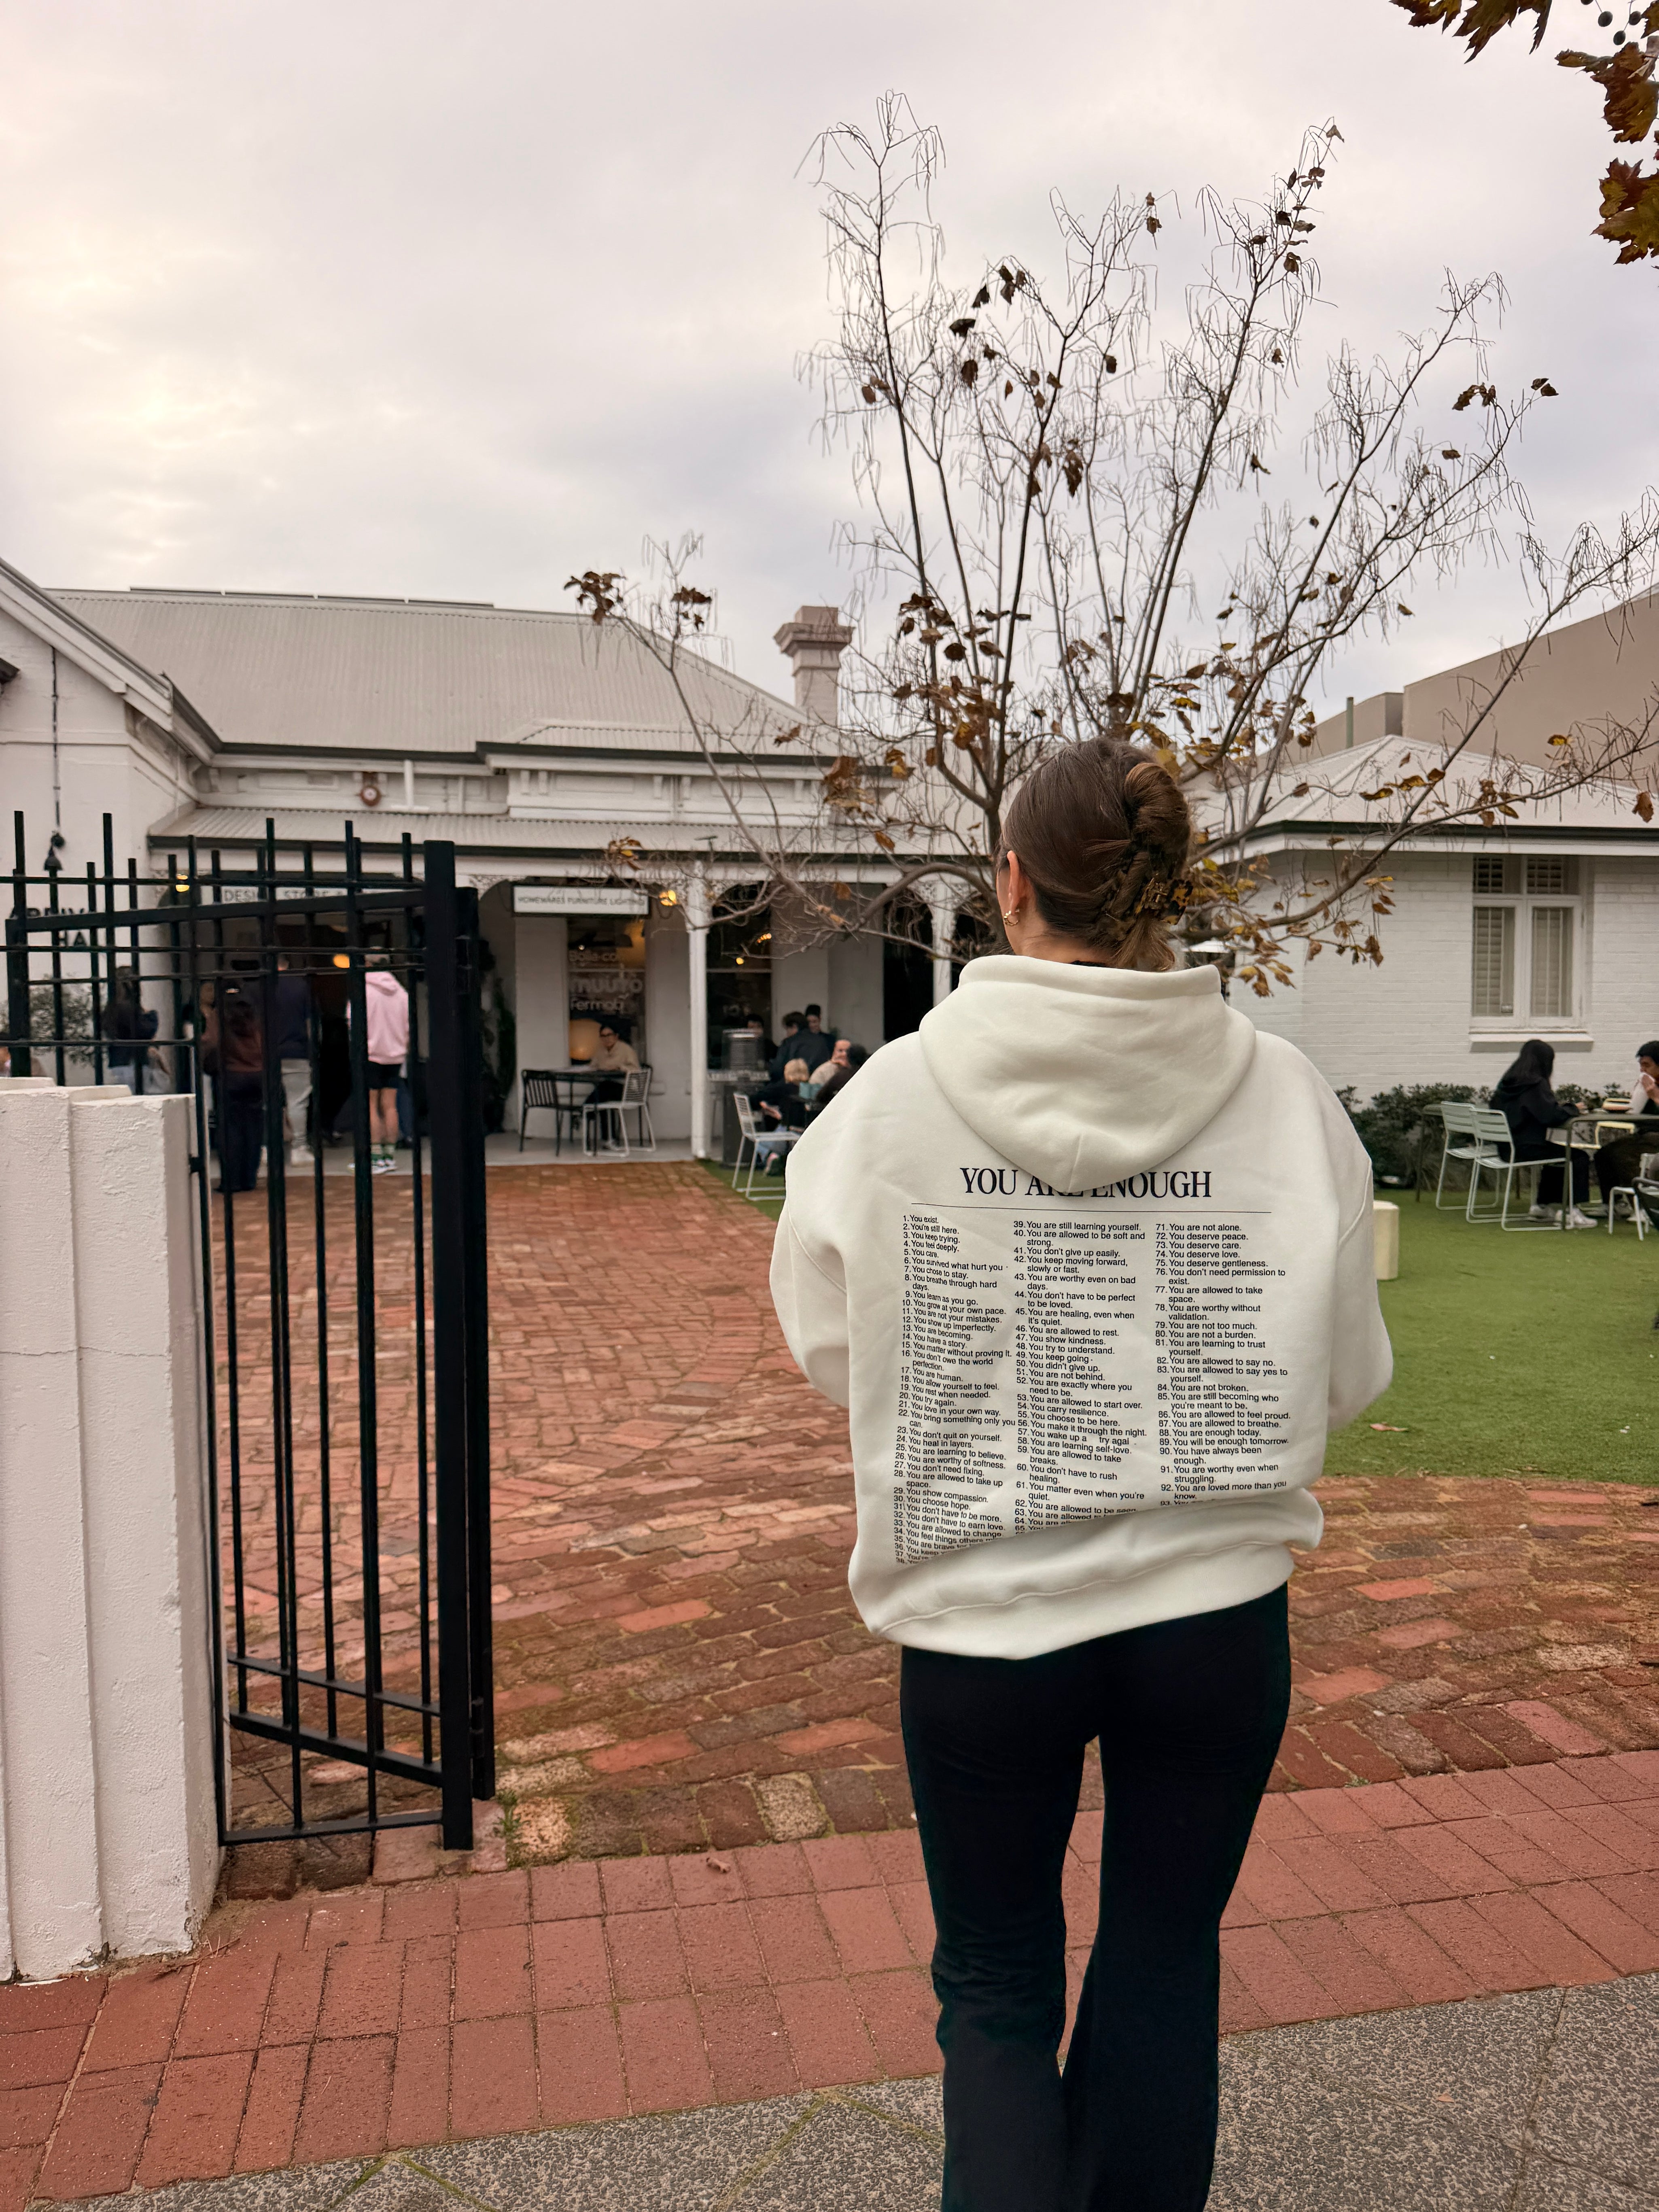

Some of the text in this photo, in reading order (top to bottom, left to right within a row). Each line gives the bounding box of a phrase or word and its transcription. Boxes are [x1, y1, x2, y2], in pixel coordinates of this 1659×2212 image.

[960, 1168, 1018, 1195] YOU
[1074, 1223, 1105, 1232] learning
[1108, 1223, 1141, 1232] yourself.
[925, 1232, 938, 1242] keep
[939, 1235, 960, 1244] trying.
[1065, 1248, 1081, 1257] give
[1096, 1250, 1120, 1259] easily.
[1044, 1257, 1063, 1265] keep
[1066, 1258, 1093, 1266] moving
[1096, 1258, 1127, 1267] forward,
[1222, 1260, 1269, 1268] gentleness.
[1027, 1265, 1051, 1274] slowly
[1232, 1269, 1275, 1277] permission
[1108, 1294, 1135, 1302] perfect
[911, 1393, 923, 1401] You
[1029, 1395, 1044, 1403] You
[1062, 1398, 1091, 1407] allowed
[911, 1402, 923, 1410] You
[924, 1404, 937, 1413] love
[1205, 1429, 1235, 1438] enough
[1237, 1429, 1261, 1438] today.
[909, 1436, 921, 1445] You
[950, 1440, 974, 1449] layers.
[1218, 1438, 1247, 1447] enough
[1213, 1447, 1239, 1456] always
[907, 1454, 921, 1462] You
[937, 1457, 962, 1466] worthy
[973, 1460, 1006, 1469] softness.
[1174, 1457, 1206, 1466] enough.
[944, 1492, 988, 1503] compassion.
